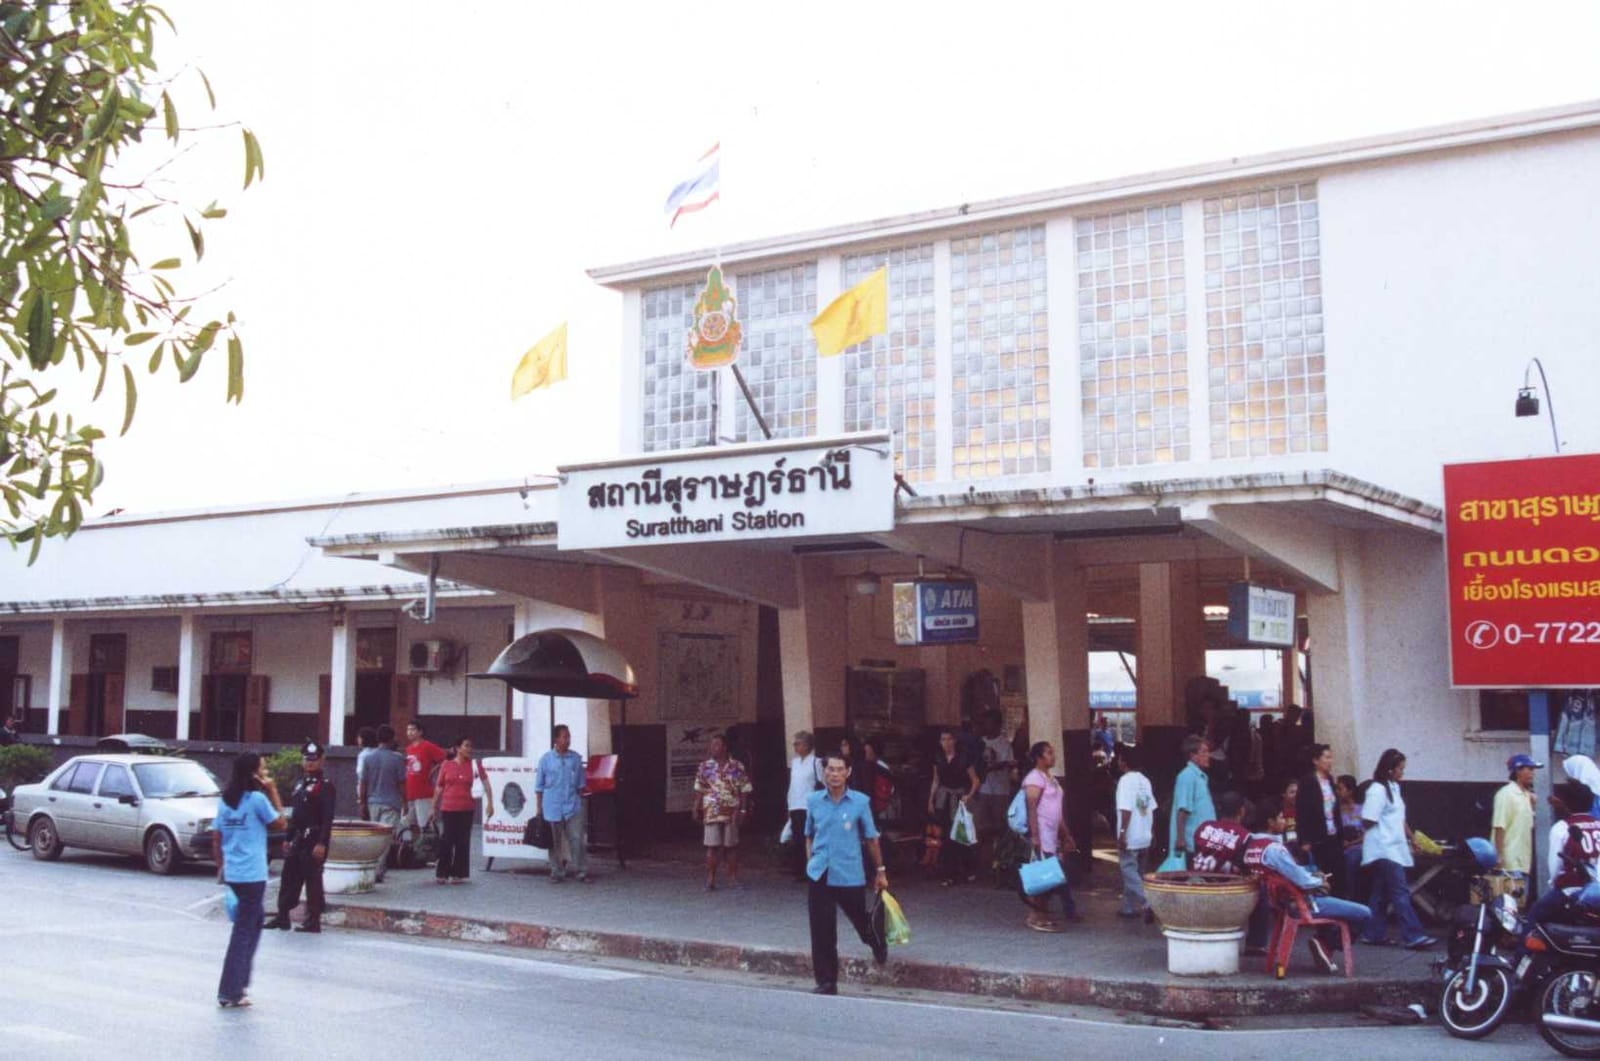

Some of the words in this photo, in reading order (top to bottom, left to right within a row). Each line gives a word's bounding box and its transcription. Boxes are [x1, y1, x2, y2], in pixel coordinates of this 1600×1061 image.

[626, 514, 723, 538] Suratthani
[731, 510, 805, 531] Station
[941, 589, 974, 608] ATM
